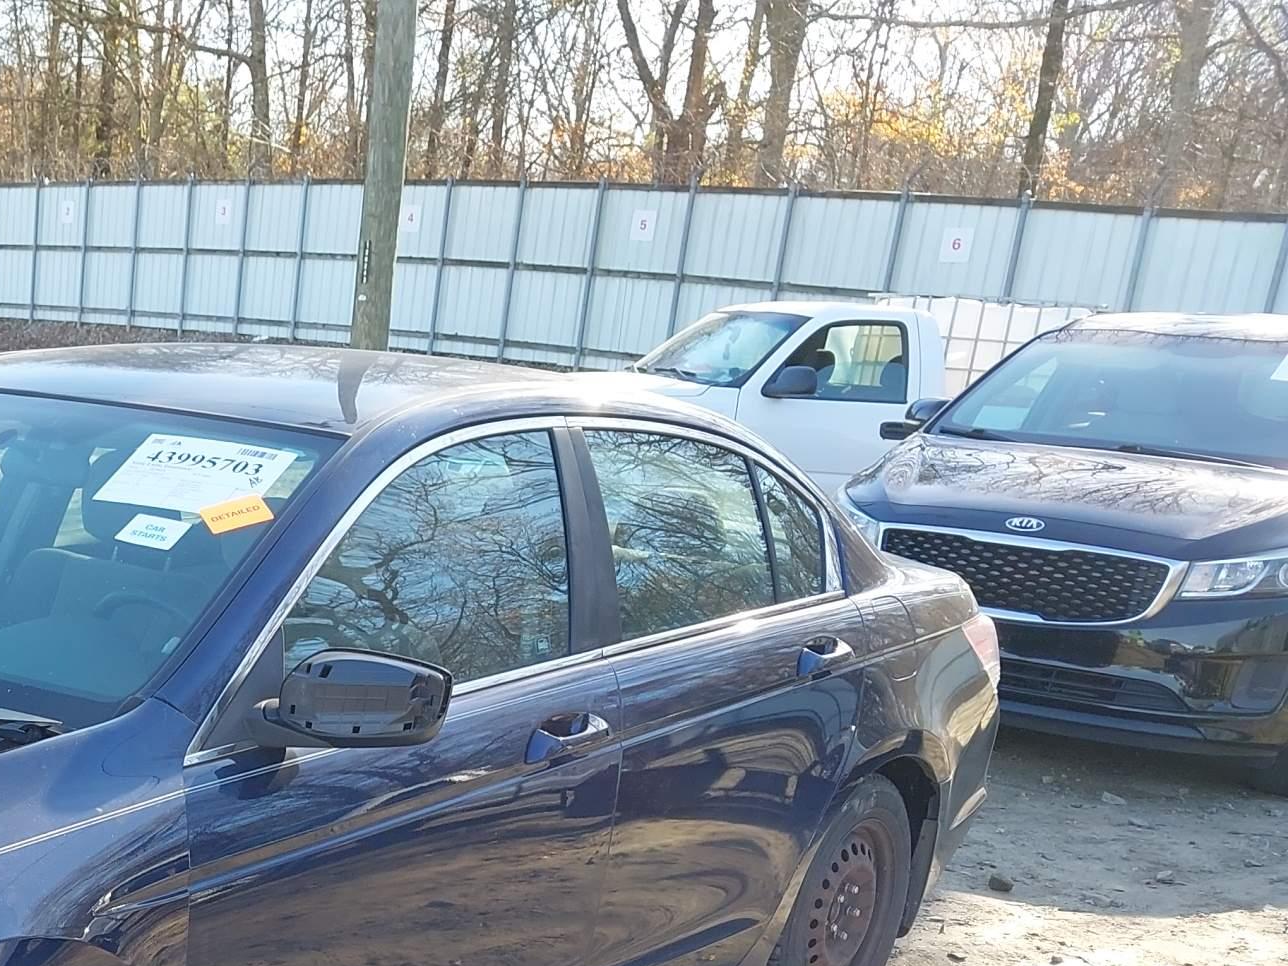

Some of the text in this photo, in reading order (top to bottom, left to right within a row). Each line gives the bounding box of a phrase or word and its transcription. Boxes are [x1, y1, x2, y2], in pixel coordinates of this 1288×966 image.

[220, 206, 227, 216] 3
[407, 212, 414, 223] 4
[639, 219, 648, 231] 5
[952, 238, 962, 251] 6
[146, 450, 263, 476] 43995703
[211, 504, 261, 523] DETAILED
[145, 523, 167, 533] CAR
[1011, 518, 1038, 529] KIA
[130, 529, 168, 542] STARTS
